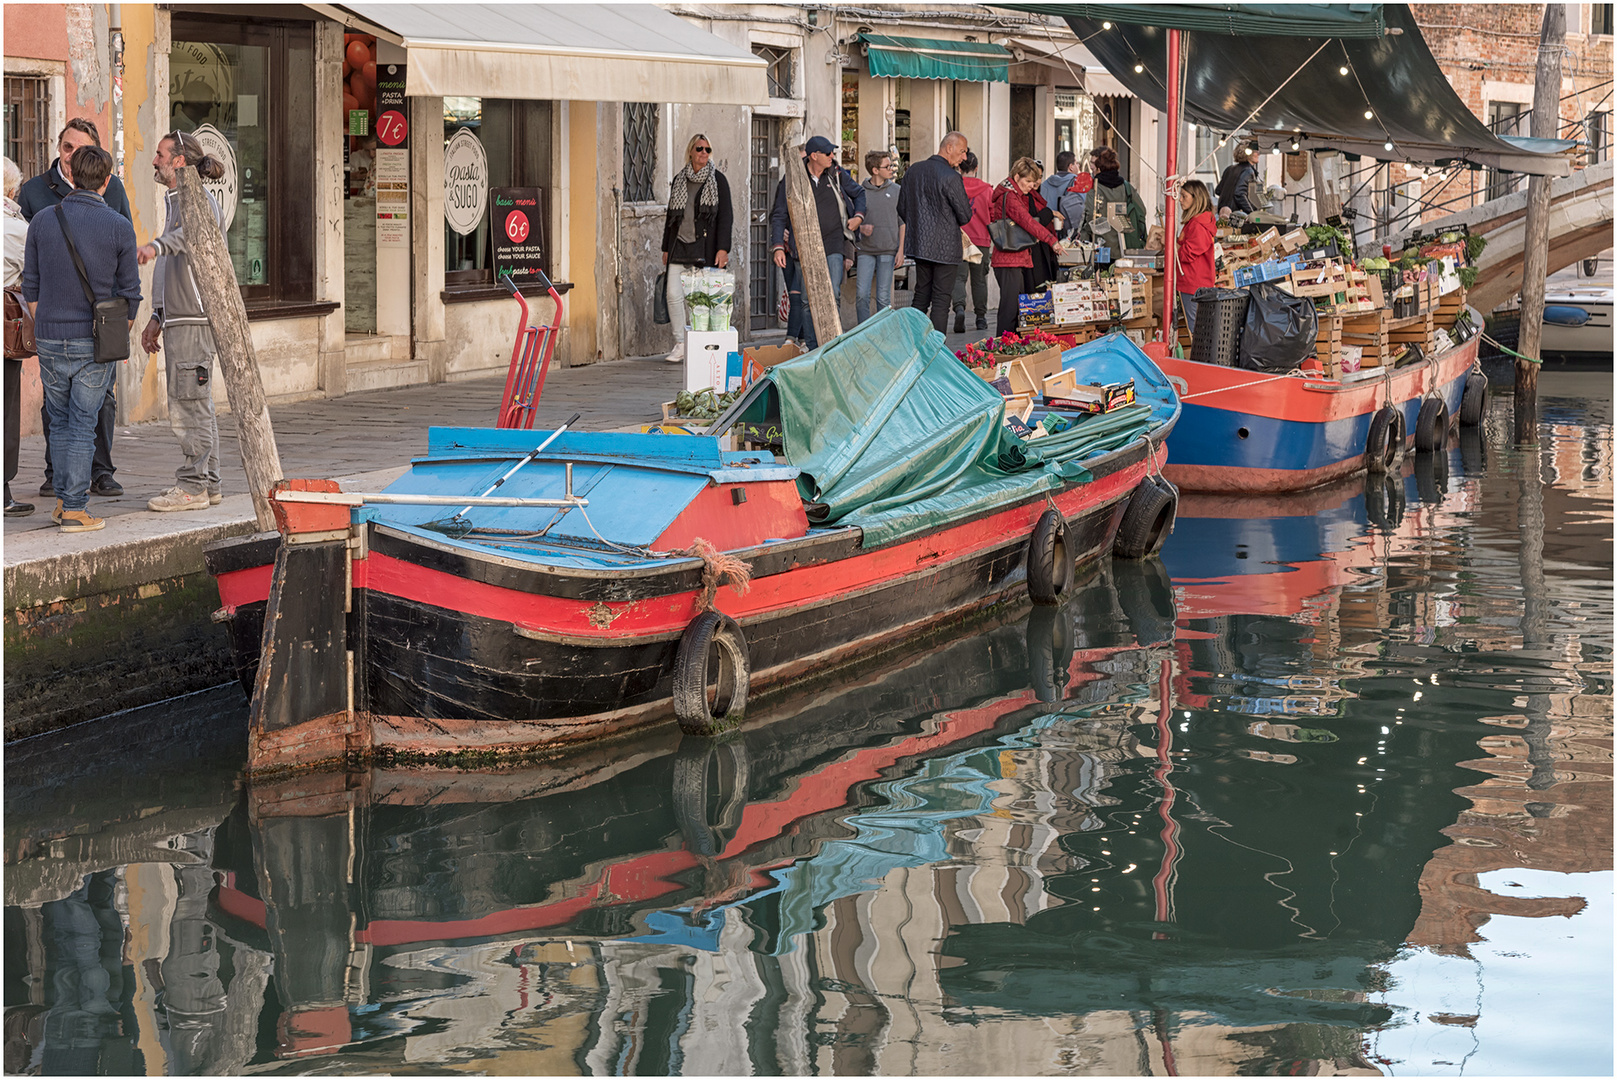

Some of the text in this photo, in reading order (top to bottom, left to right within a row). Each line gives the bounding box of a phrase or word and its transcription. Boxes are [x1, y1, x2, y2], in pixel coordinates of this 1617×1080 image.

[187, 44, 208, 65] FOOD
[202, 138, 227, 161] STREET FOOD
[448, 139, 480, 160] ITALIAN STREET FOOD
[448, 183, 478, 209] & SUGO
[495, 194, 514, 206] basic
